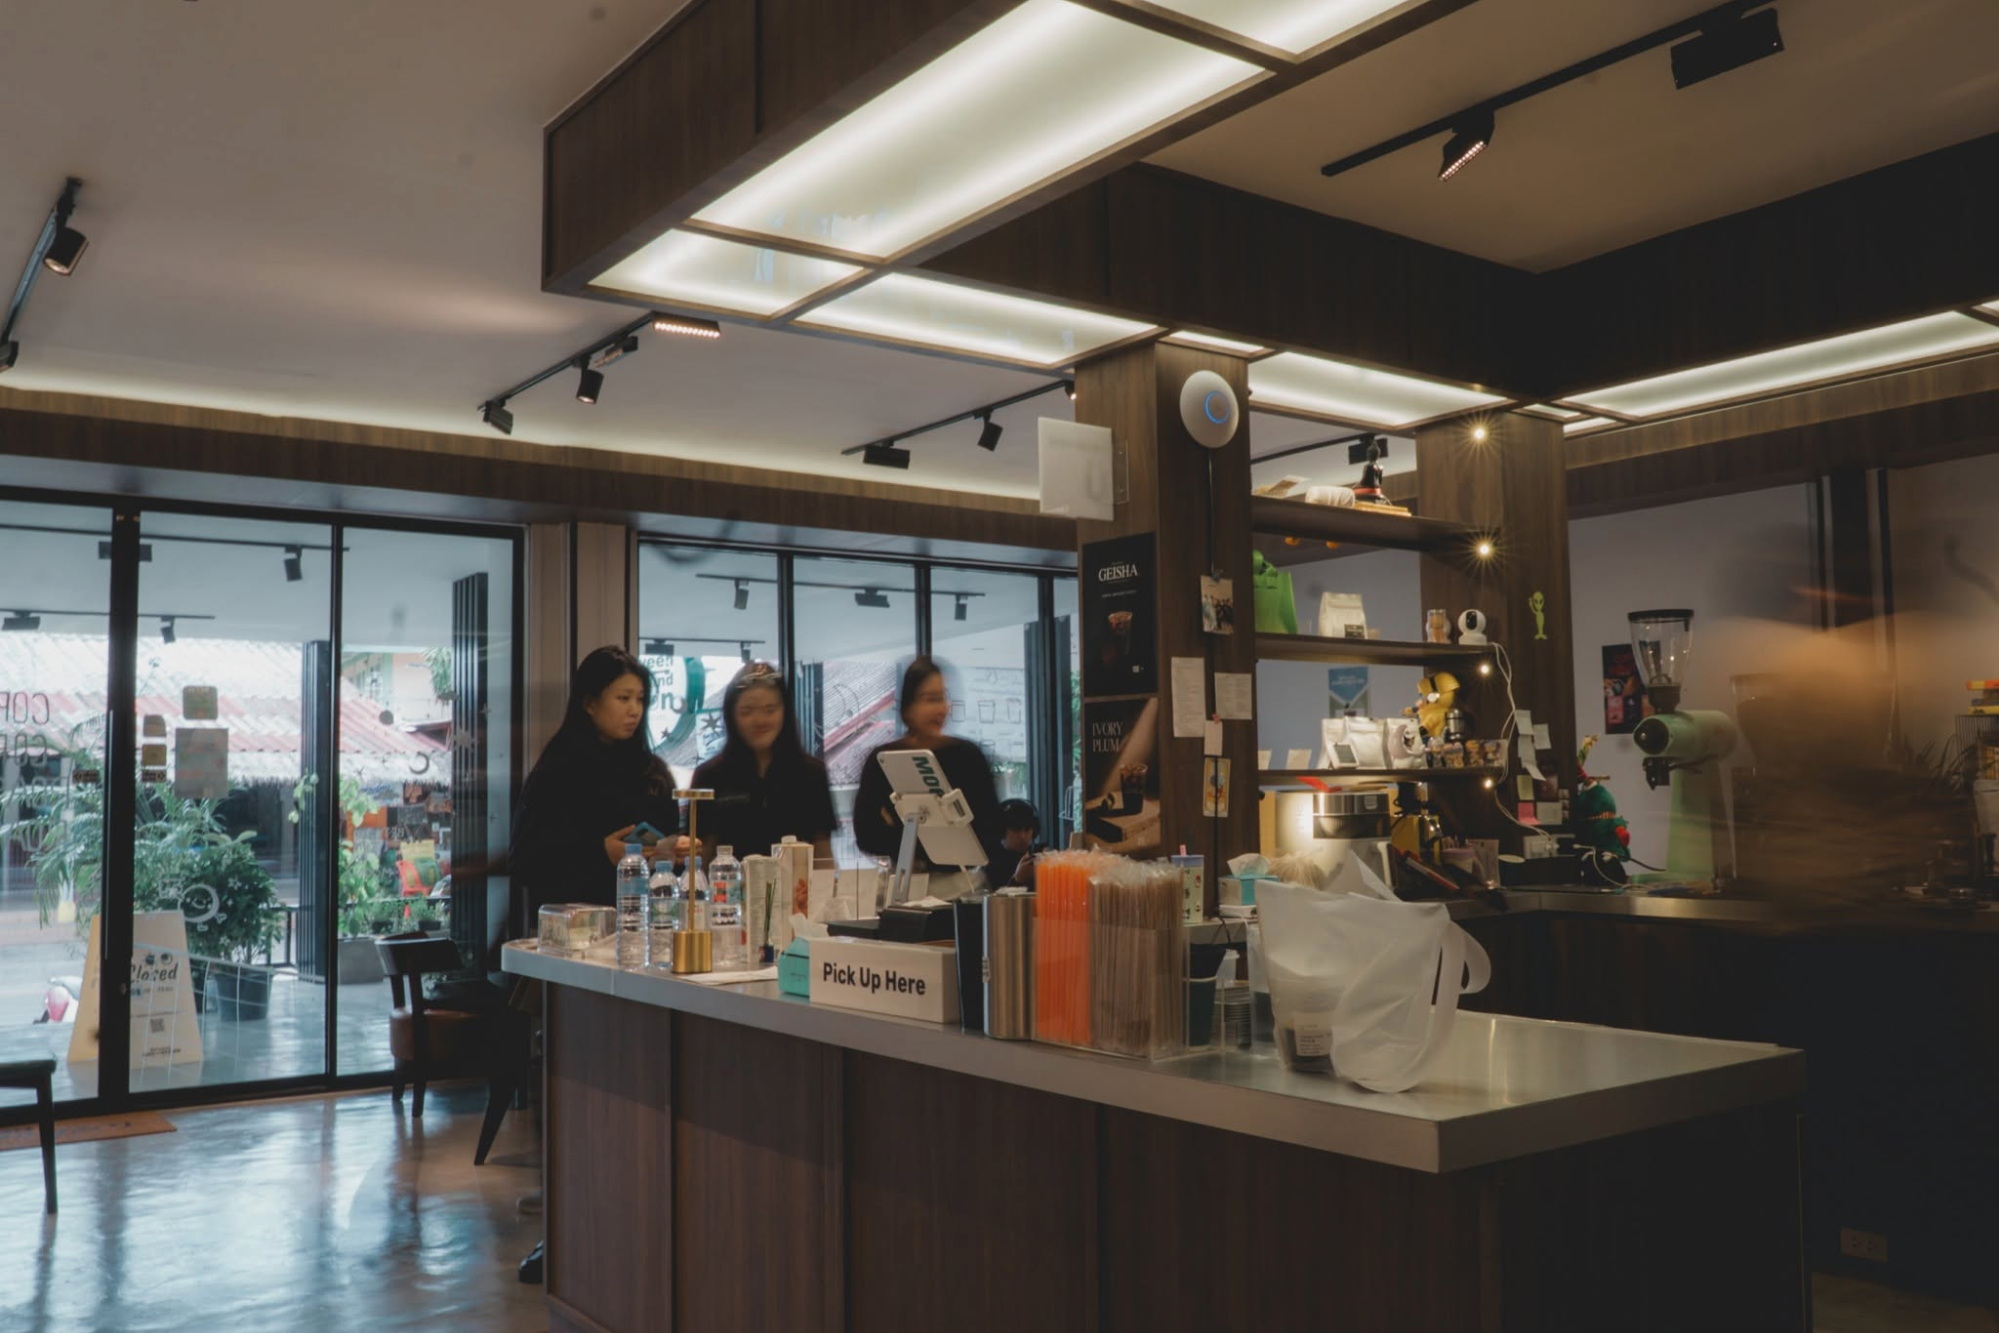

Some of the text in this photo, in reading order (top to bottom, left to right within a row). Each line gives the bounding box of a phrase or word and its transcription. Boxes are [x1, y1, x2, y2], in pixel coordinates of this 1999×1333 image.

[1098, 563, 1139, 582] GEISHA
[1092, 720, 1123, 737] IVORY
[1092, 738, 1120, 753] PLUM
[823, 962, 926, 995] Pick Up Here
